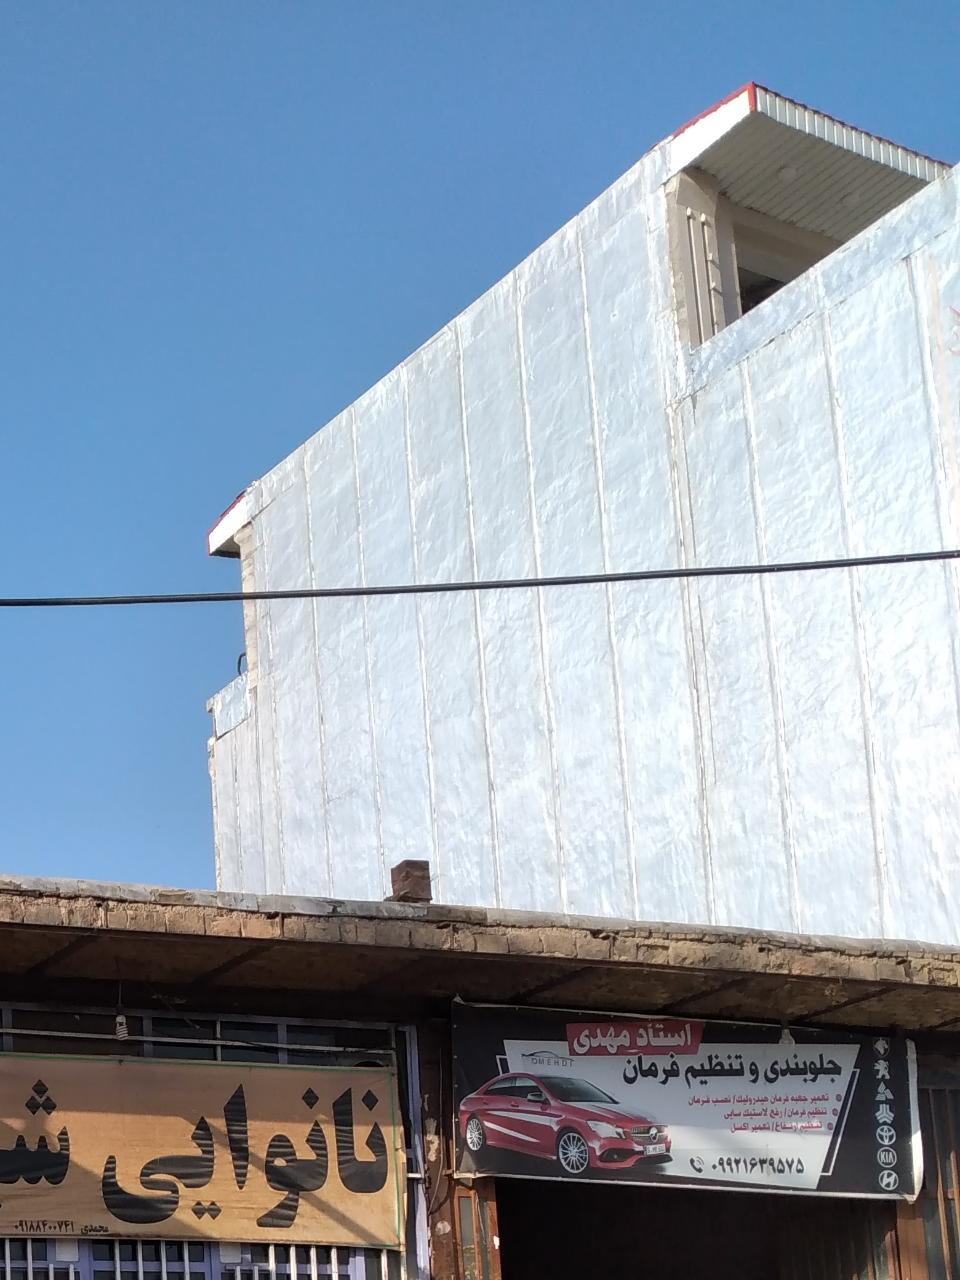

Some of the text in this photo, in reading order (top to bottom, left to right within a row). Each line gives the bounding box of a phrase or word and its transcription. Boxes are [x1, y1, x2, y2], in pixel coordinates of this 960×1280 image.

[573, 1023, 691, 1054] استاد مهدی
[622, 1051, 843, 1089] جلوبندی و تنظیم فرمان
[101, 1083, 389, 1229] نانوایی
[711, 1156, 805, 1175] ۰۹۹۲۱۶۳۹۵۷۵
